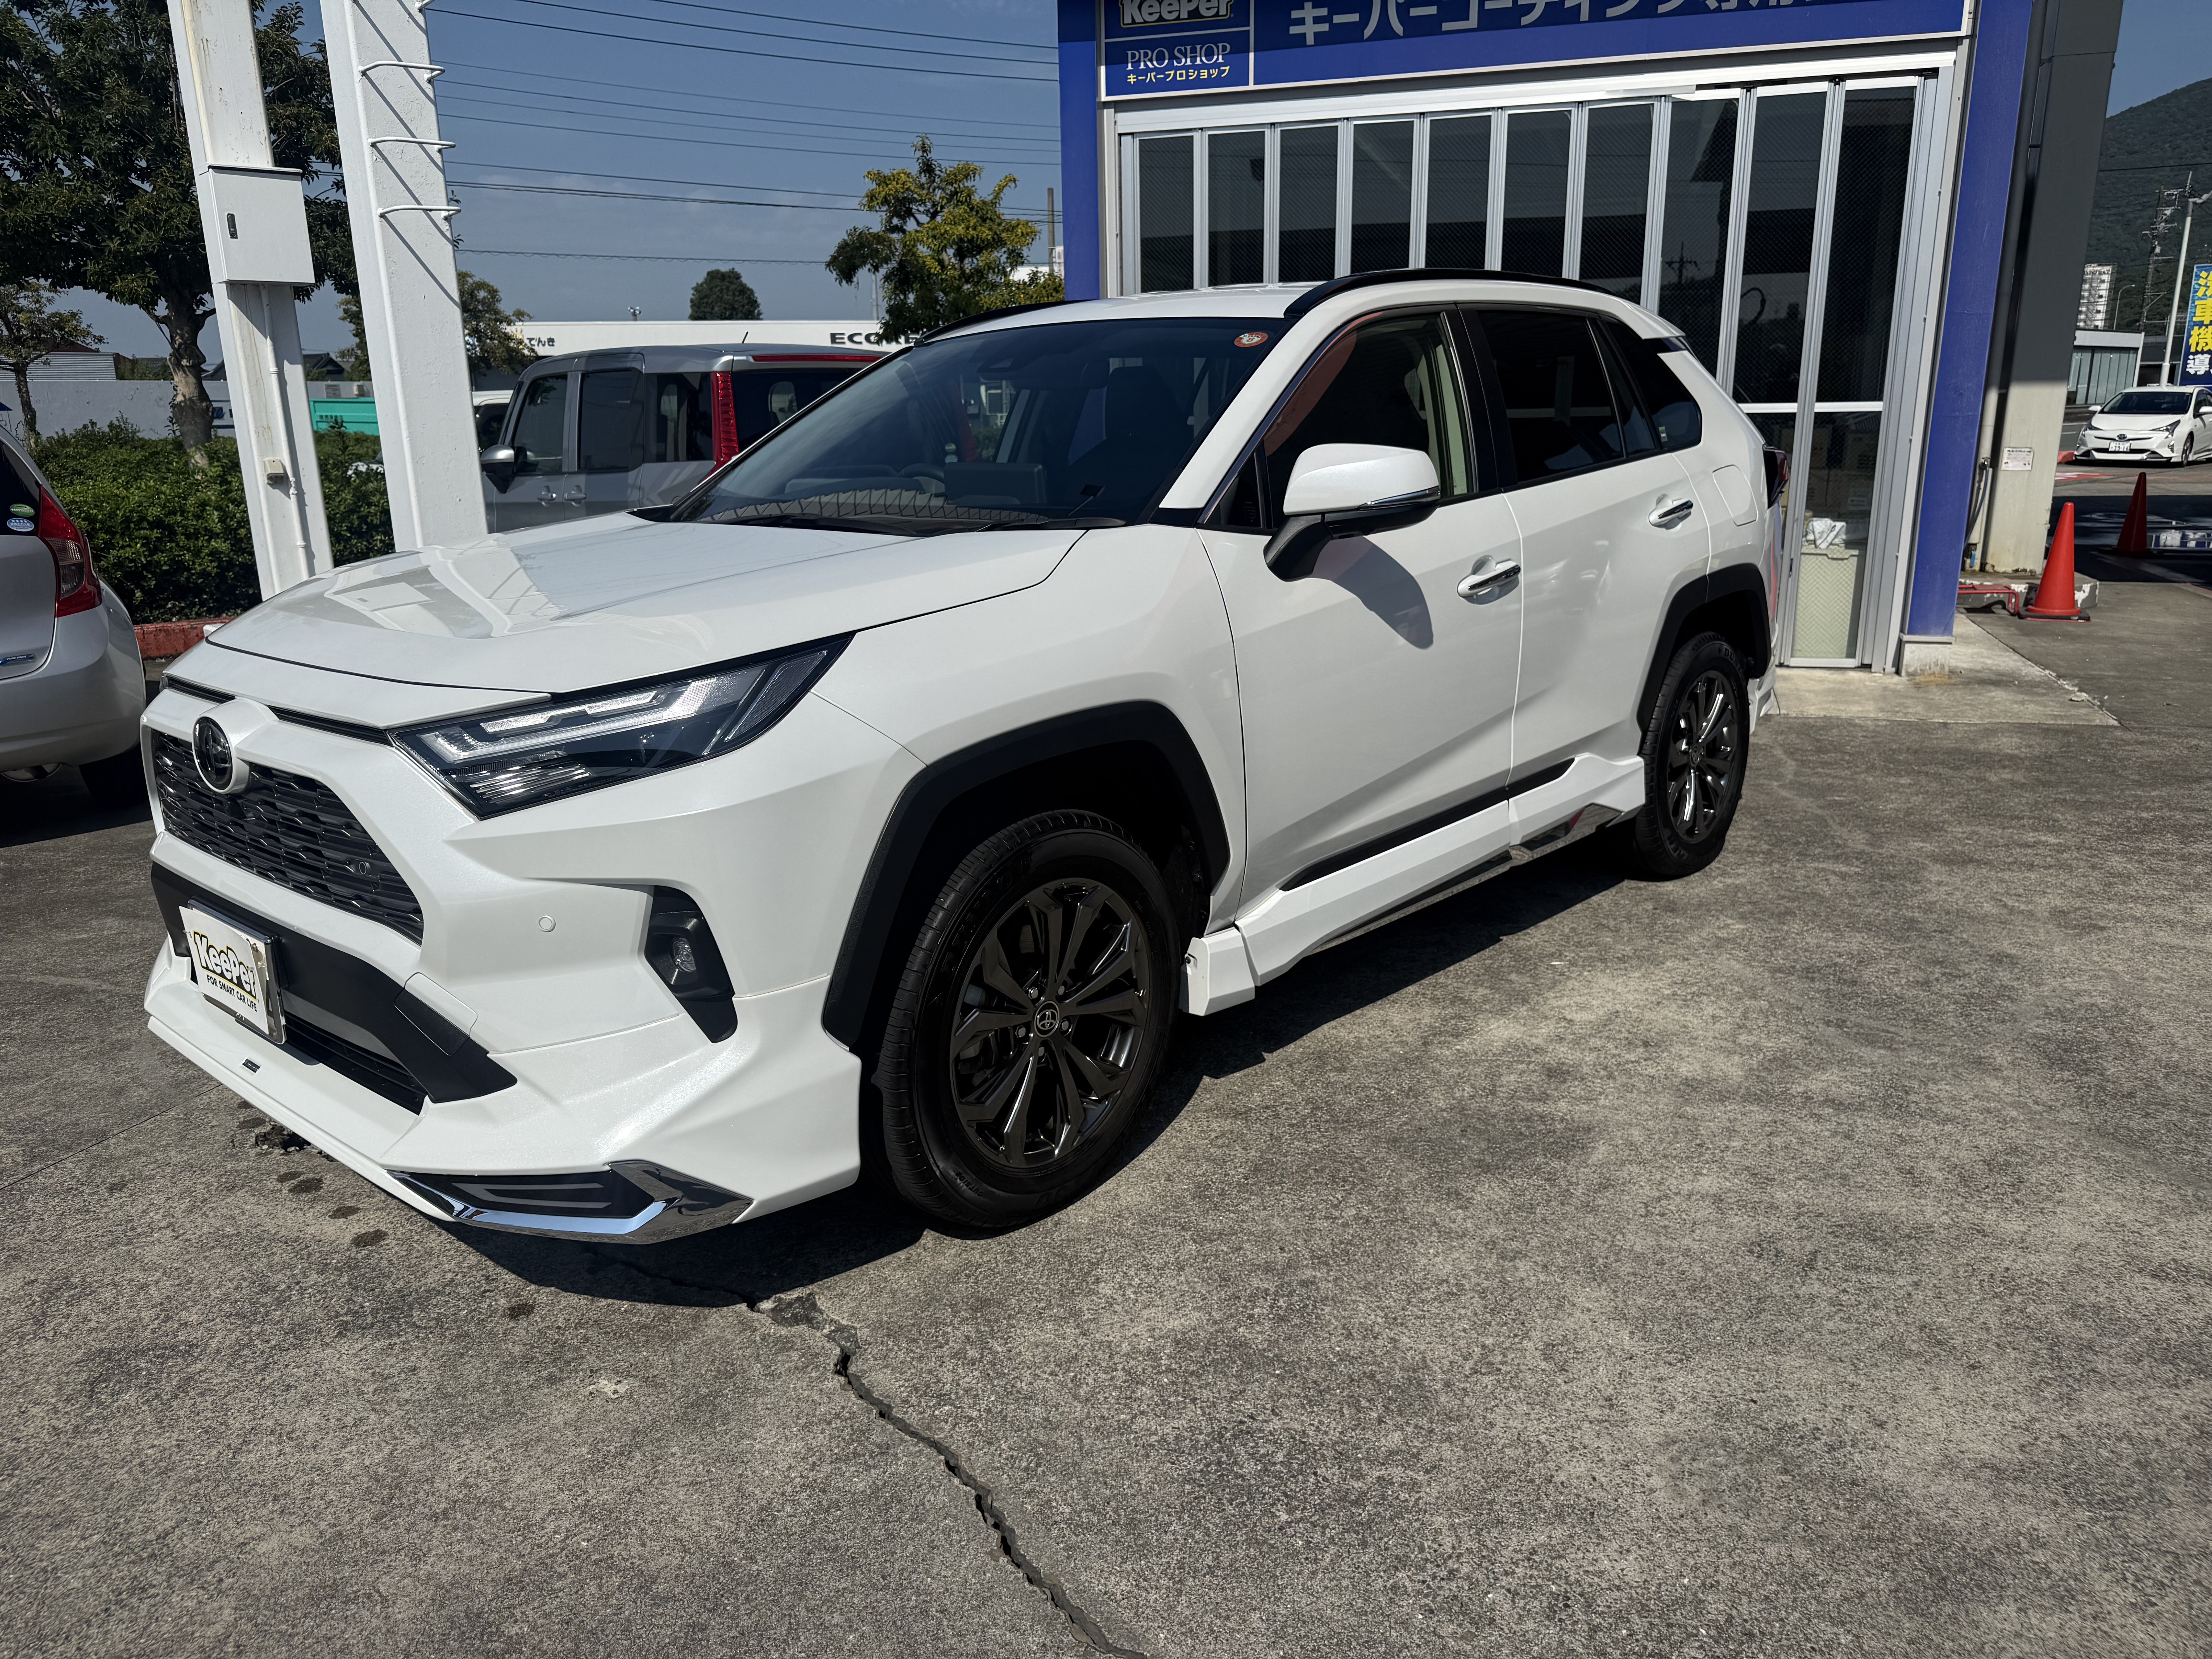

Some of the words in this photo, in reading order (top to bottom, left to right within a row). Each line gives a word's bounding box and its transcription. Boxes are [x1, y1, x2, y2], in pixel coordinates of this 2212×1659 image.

[1122, 0, 1231, 24] KeePer
[1126, 48, 1169, 70] PRO
[1173, 43, 1231, 67] SHOP
[1127, 65, 1230, 84] キーパープロショップ
[194, 932, 257, 999] KeePer
[206, 974, 218, 987] FOR
[219, 981, 235, 997] SMART
[236, 991, 246, 1002] CAR
[247, 998, 257, 1012] LIFE
